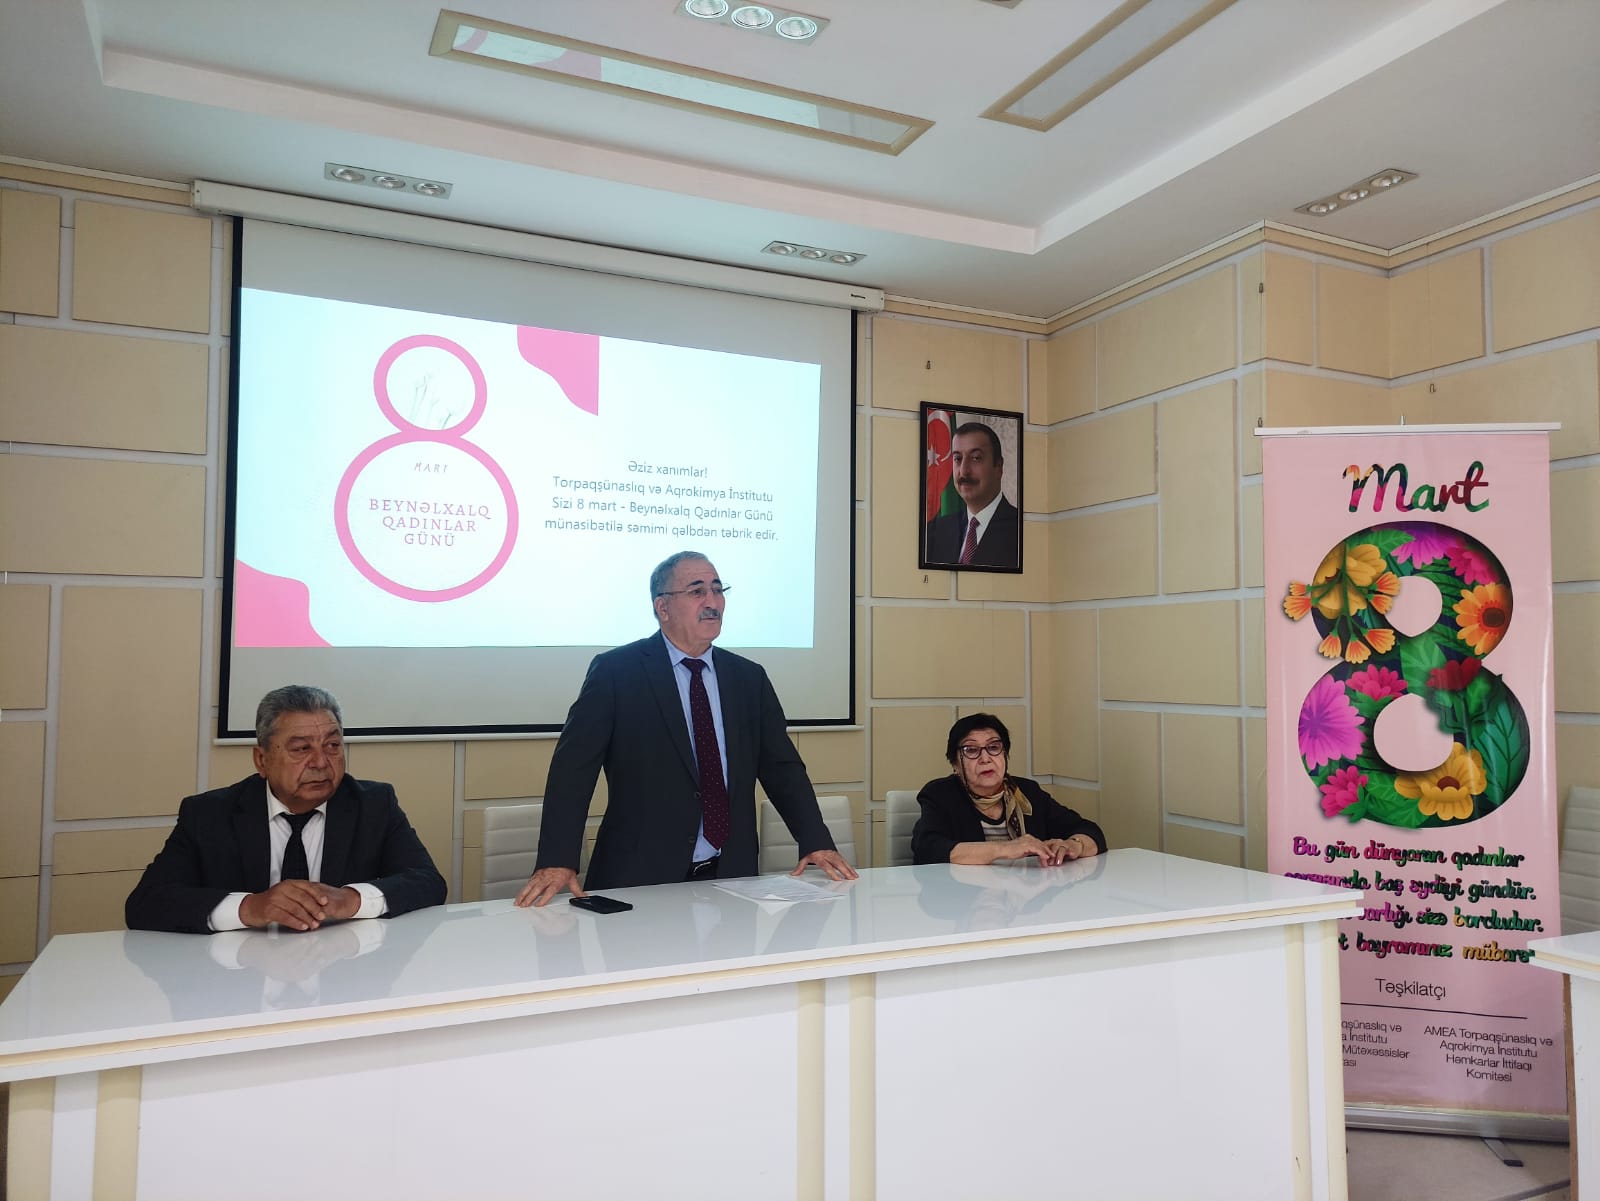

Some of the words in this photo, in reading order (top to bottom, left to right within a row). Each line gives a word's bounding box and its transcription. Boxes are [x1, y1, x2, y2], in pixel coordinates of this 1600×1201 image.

[628, 460, 653, 473] Əziz
[656, 465, 708, 478] xanımlar!
[552, 475, 645, 496] Torpaqşünaslıq
[648, 485, 662, 494] və
[665, 484, 726, 501] Aqrokimya
[729, 486, 773, 502] İnstitutu
[1342, 461, 1489, 512] Mart
[368, 498, 492, 520] BEYNƏLXALQ
[552, 496, 573, 509] Sizi
[576, 498, 585, 510] 8
[588, 501, 617, 512] mart
[629, 501, 691, 519] Beynəlxalq
[694, 506, 742, 520] Qadınlar
[744, 509, 773, 521] Günü
[382, 515, 477, 532] QADINLAR
[544, 518, 623, 532] münasibətilə
[627, 521, 668, 534] səmimi
[671, 524, 718, 538] qəlbdən
[721, 527, 752, 539] təbrik
[404, 531, 455, 547] GÜNÜ
[1292, 836, 1321, 857] Bu
[1323, 840, 1361, 863] gün
[1451, 845, 1525, 871] qadınlar
[1375, 870, 1405, 897] baş
[1375, 978, 1446, 1000] Təşkilatçı
[1389, 1023, 1402, 1032] və
[1424, 1025, 1457, 1038] AMEA
[1540, 1037, 1553, 1046] və
[1440, 1040, 1495, 1055] Aqrokimya
[1446, 1054, 1500, 1068] Həmkarlar
[1466, 1068, 1512, 1082] Komitəsi
